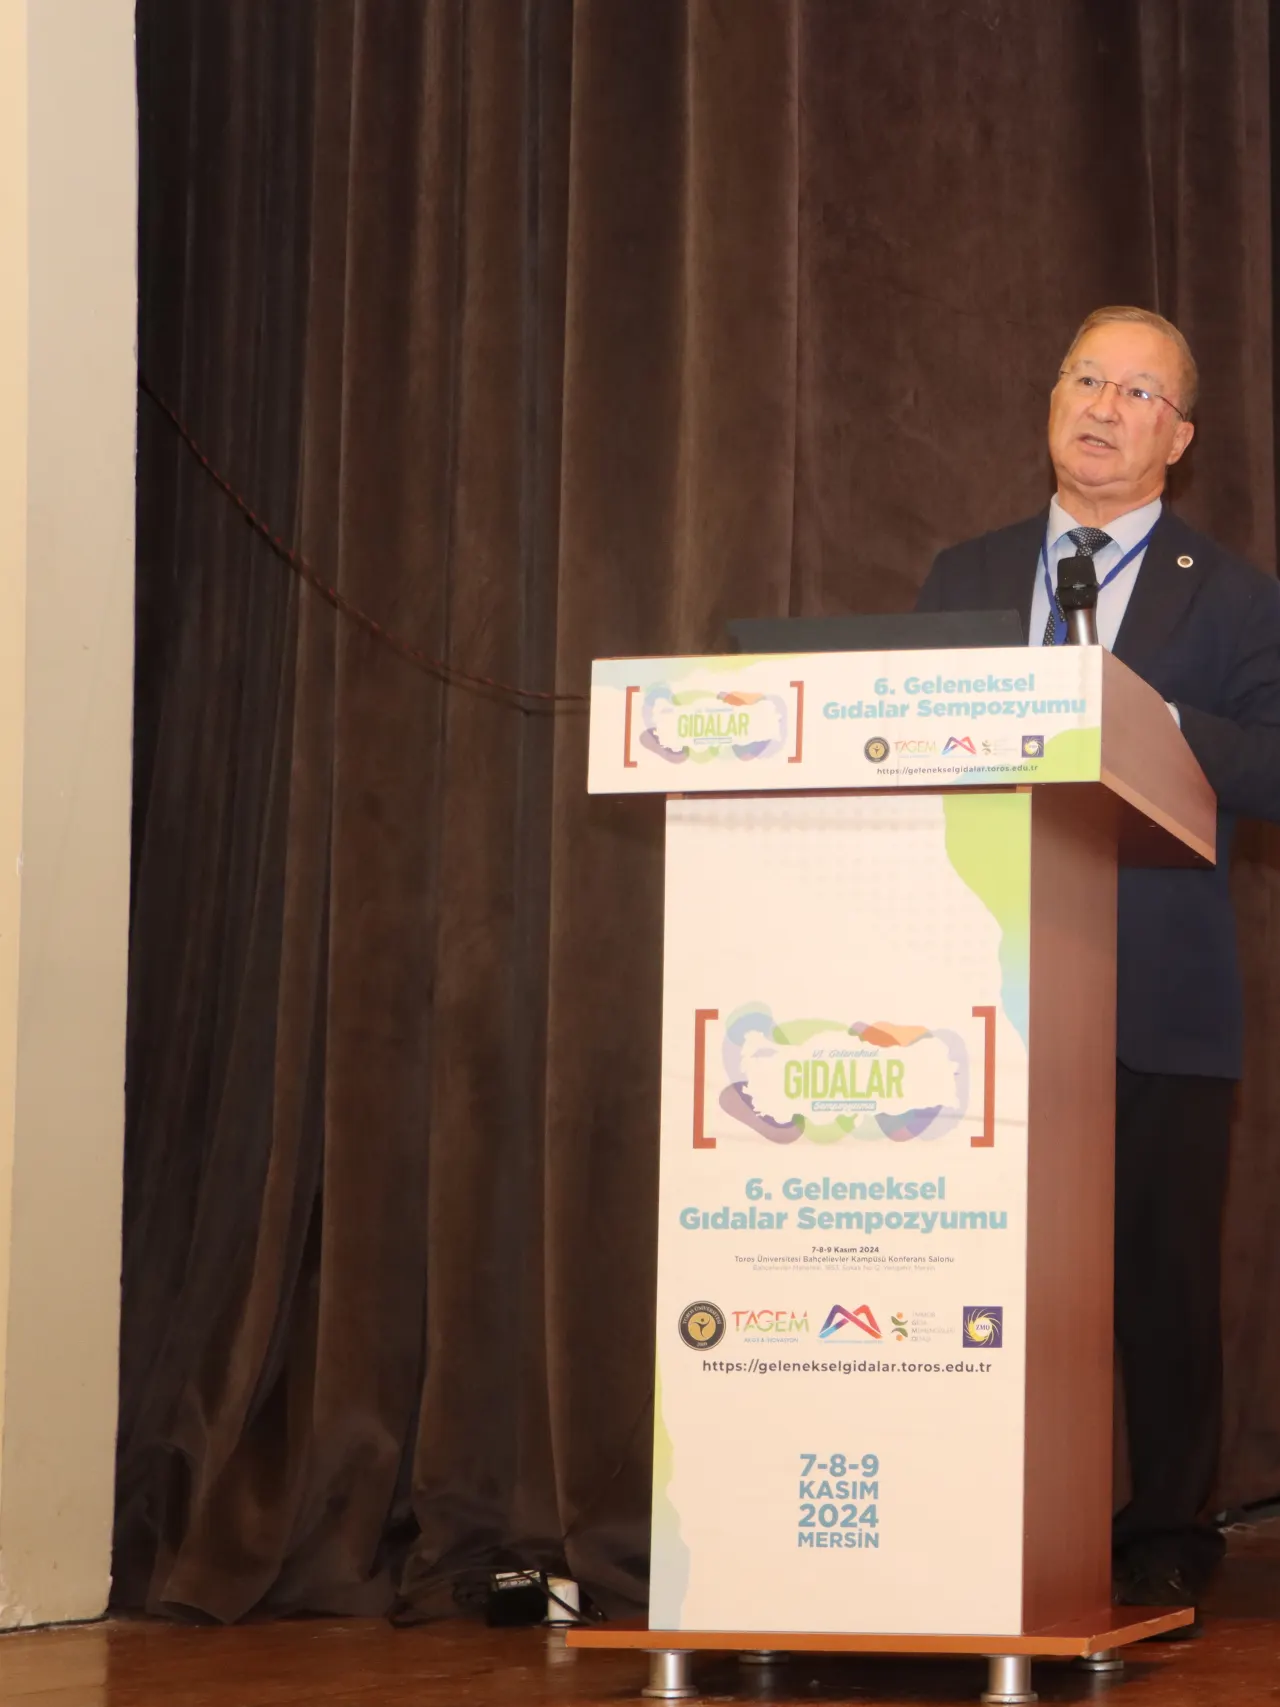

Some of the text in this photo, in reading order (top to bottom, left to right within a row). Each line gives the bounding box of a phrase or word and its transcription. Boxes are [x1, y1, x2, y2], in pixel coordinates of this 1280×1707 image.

[873, 673, 1036, 697] 6. Geleneksel
[822, 695, 1087, 720] Gıdalar Sempozyumu
[677, 713, 750, 738] GIDALAR
[876, 765, 1039, 776] https://gelenekselgidalar.toros.edu.tr
[784, 1059, 905, 1099] GIDALAR
[745, 1177, 946, 1200] 6. Geleneksel
[679, 1207, 1008, 1234] Gıdalar Sempozyumu
[811, 1246, 832, 1254] 7-8-9
[834, 1246, 858, 1254] Kasım
[889, 1255, 926, 1263] Konferans
[928, 1255, 955, 1263] Salonu
[732, 1309, 810, 1333] TAGEM
[702, 1359, 992, 1375] https://gelenekselgidalar.toros.edu.tr
[799, 1454, 880, 1478] 7-8-9
[799, 1480, 879, 1500] KASIM
[798, 1503, 879, 1528] 2024
[797, 1528, 880, 1549] MERSİN
